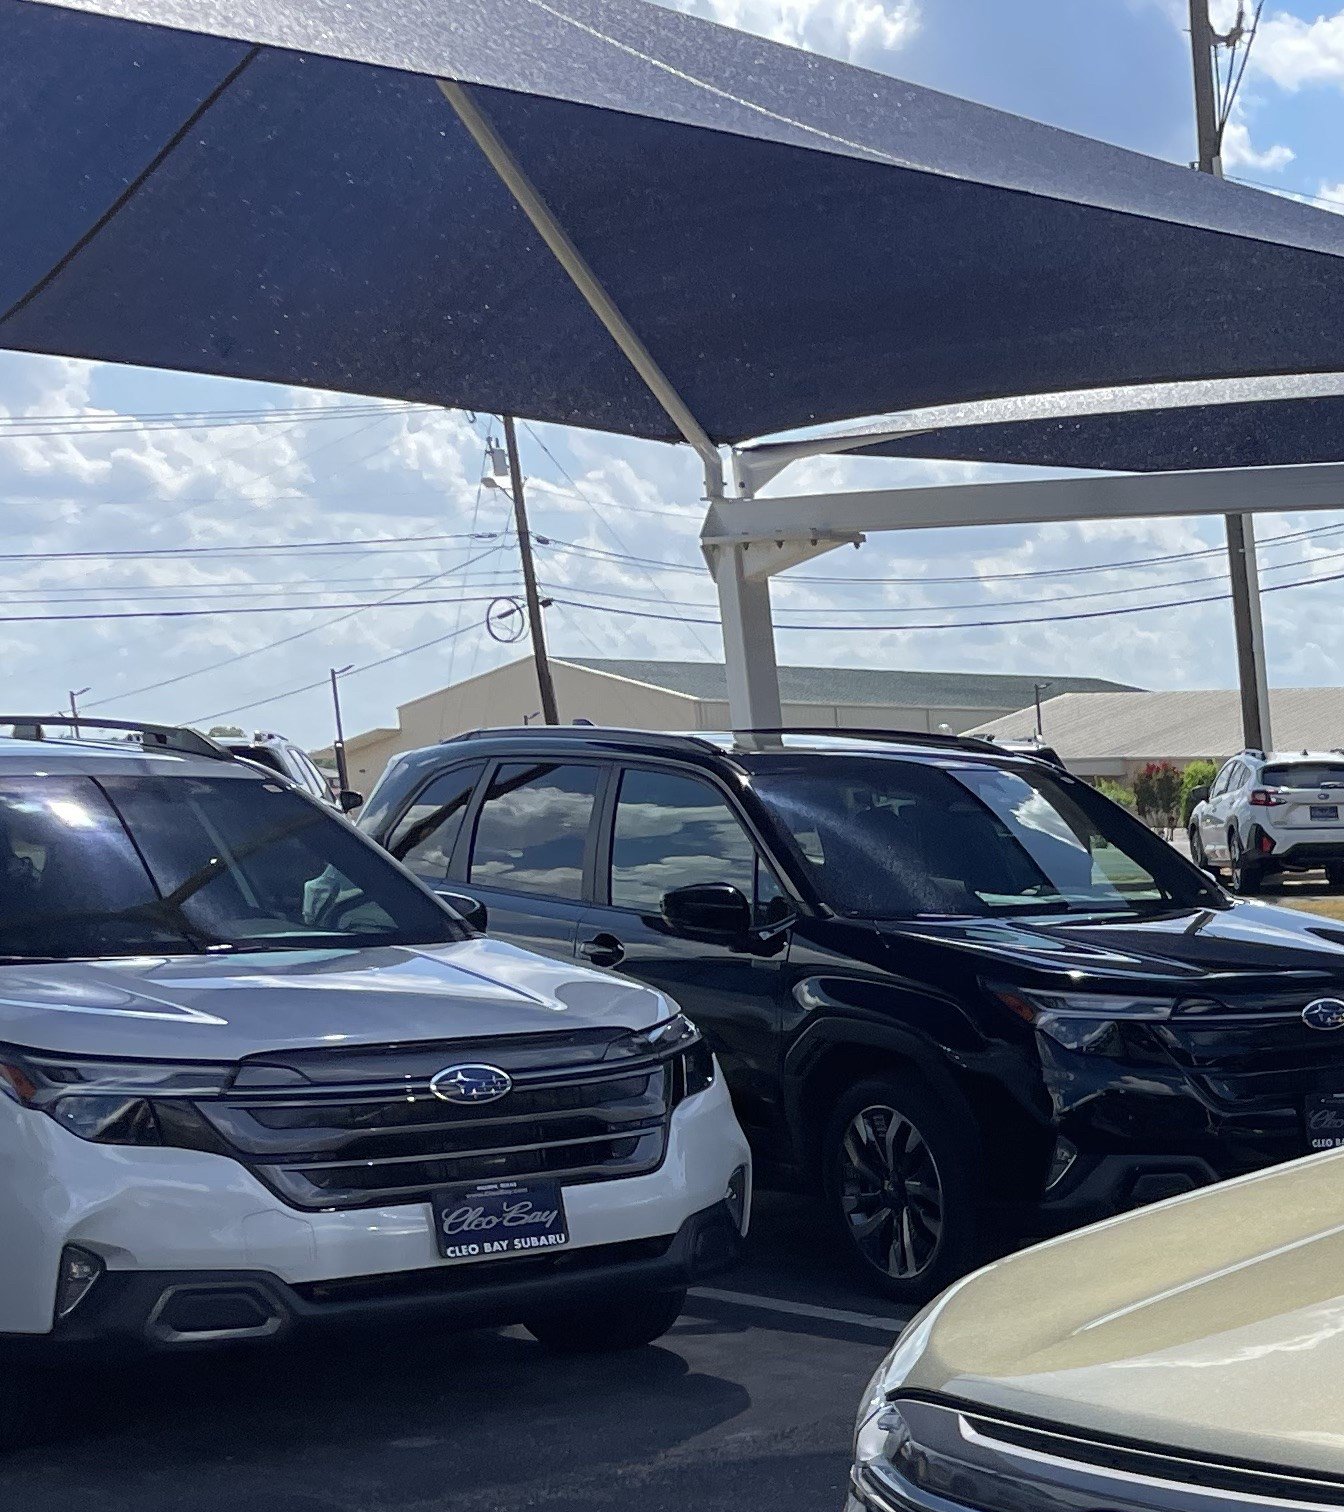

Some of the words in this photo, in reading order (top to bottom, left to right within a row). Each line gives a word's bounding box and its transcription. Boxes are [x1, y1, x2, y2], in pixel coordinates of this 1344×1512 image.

[1312, 1138, 1334, 1148] CLEO
[442, 1206, 500, 1235] Cleo
[502, 1201, 558, 1228] Bay
[446, 1244, 479, 1258] CLEO
[484, 1240, 510, 1253] BAY
[514, 1233, 566, 1250] SUBARU
